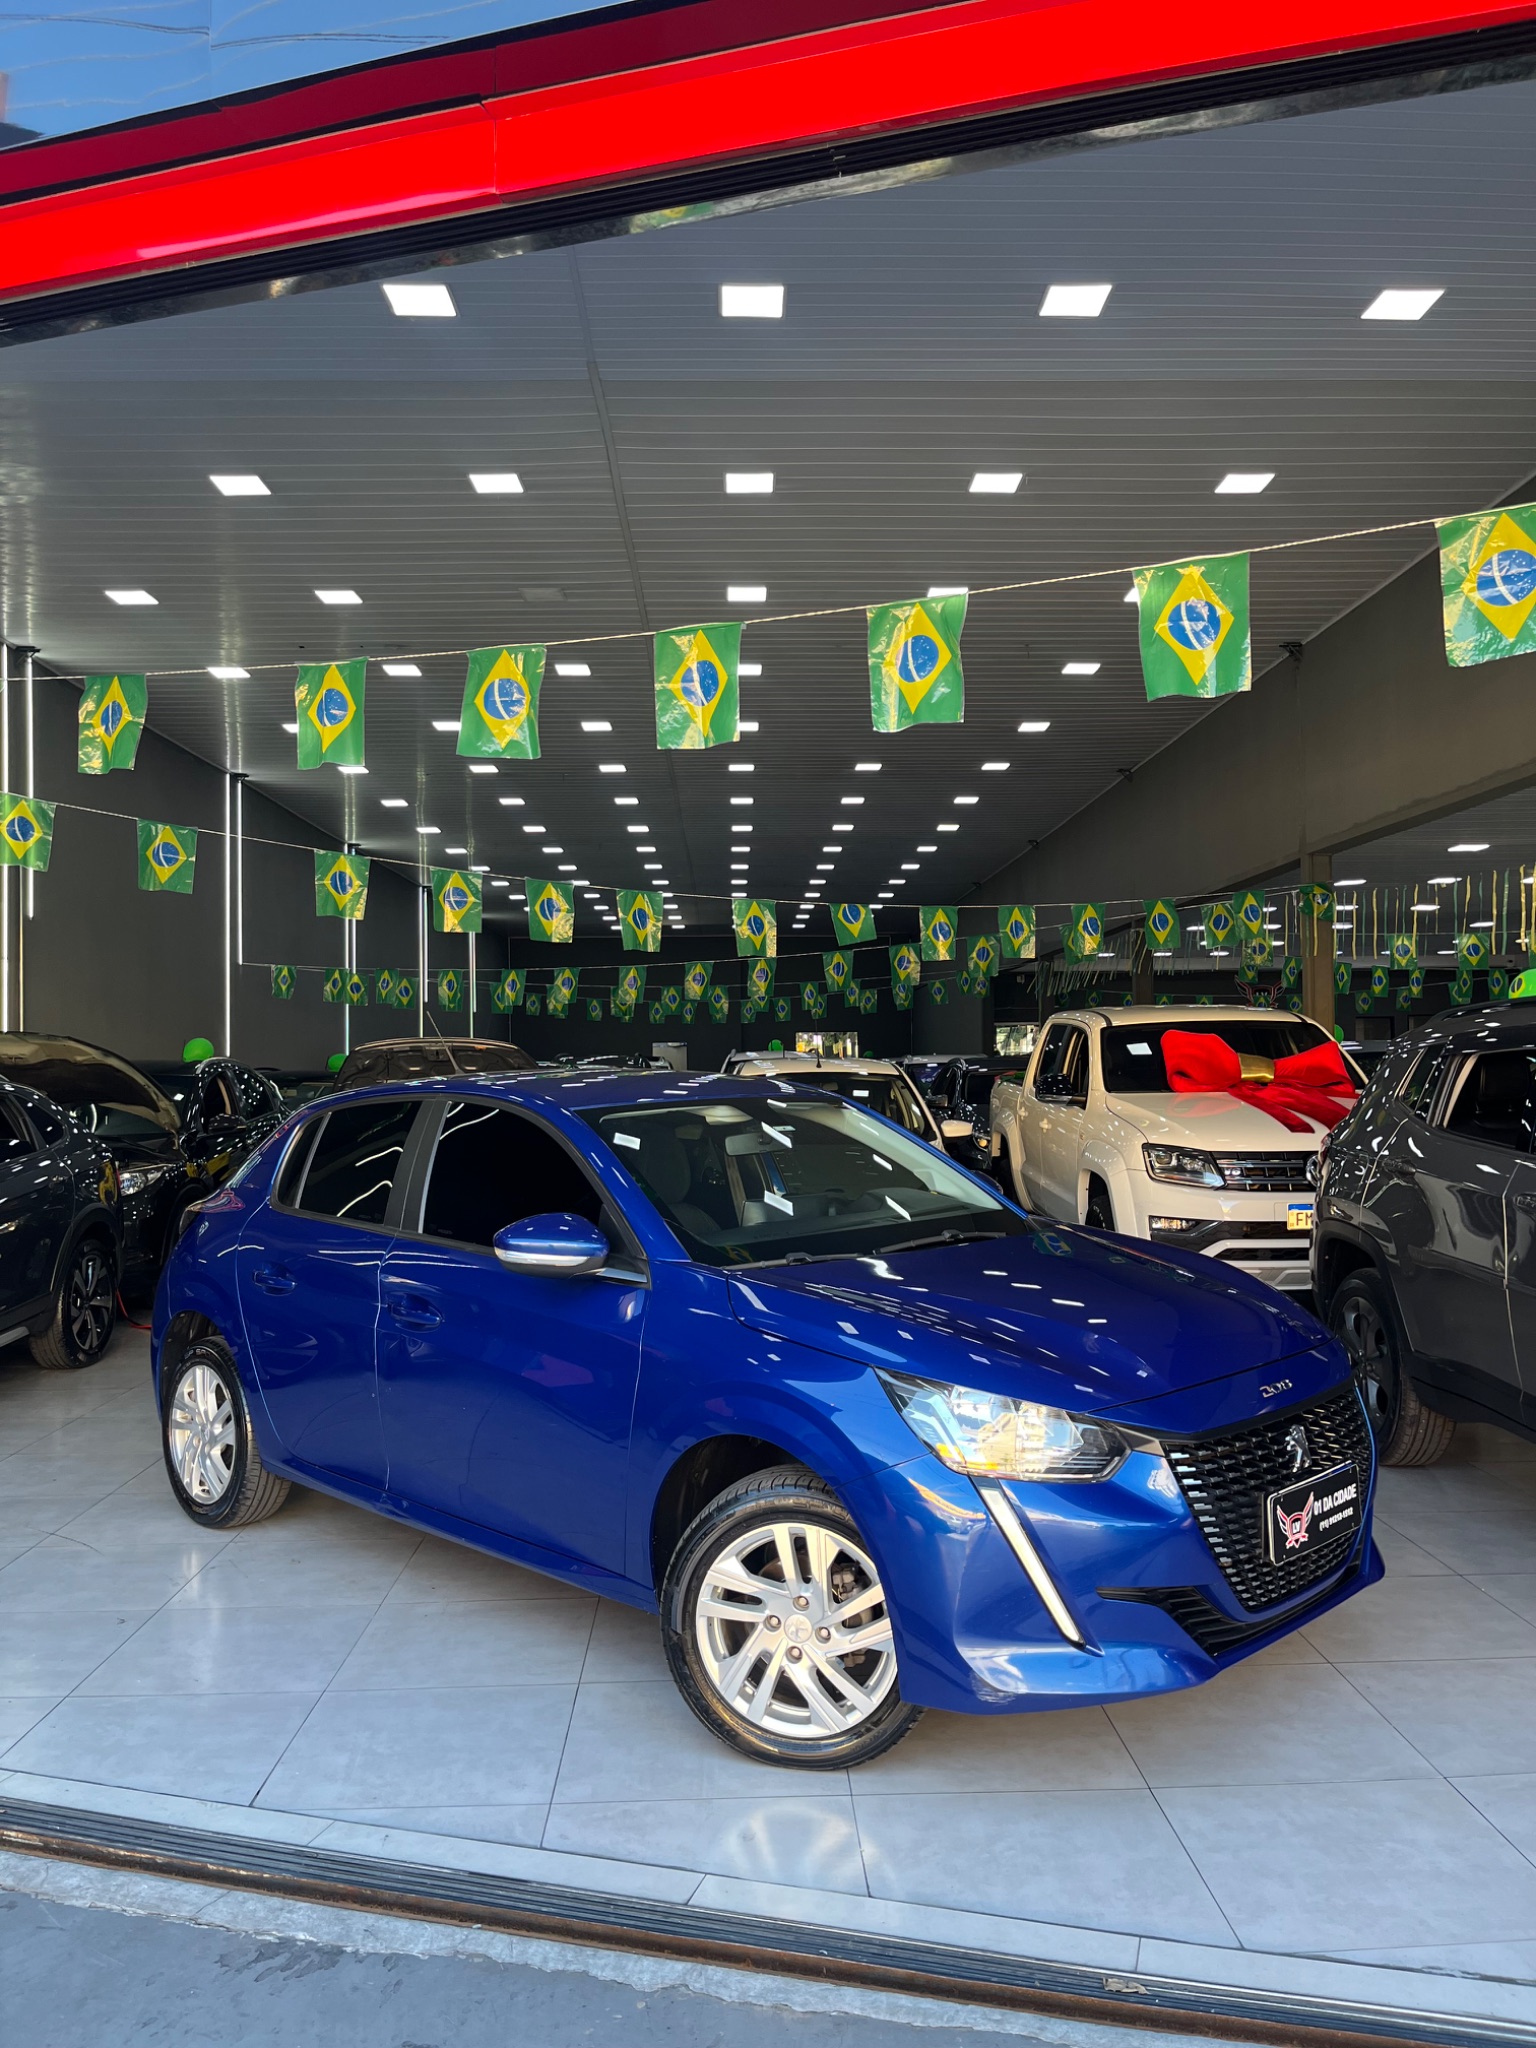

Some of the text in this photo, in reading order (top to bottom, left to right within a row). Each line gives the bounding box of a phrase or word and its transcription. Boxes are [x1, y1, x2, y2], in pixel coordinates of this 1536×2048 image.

[1259, 1379, 1293, 1398] 208
[1313, 1483, 1357, 1516] 01 DA CIDADE
[1292, 1520, 1301, 1534] LV
